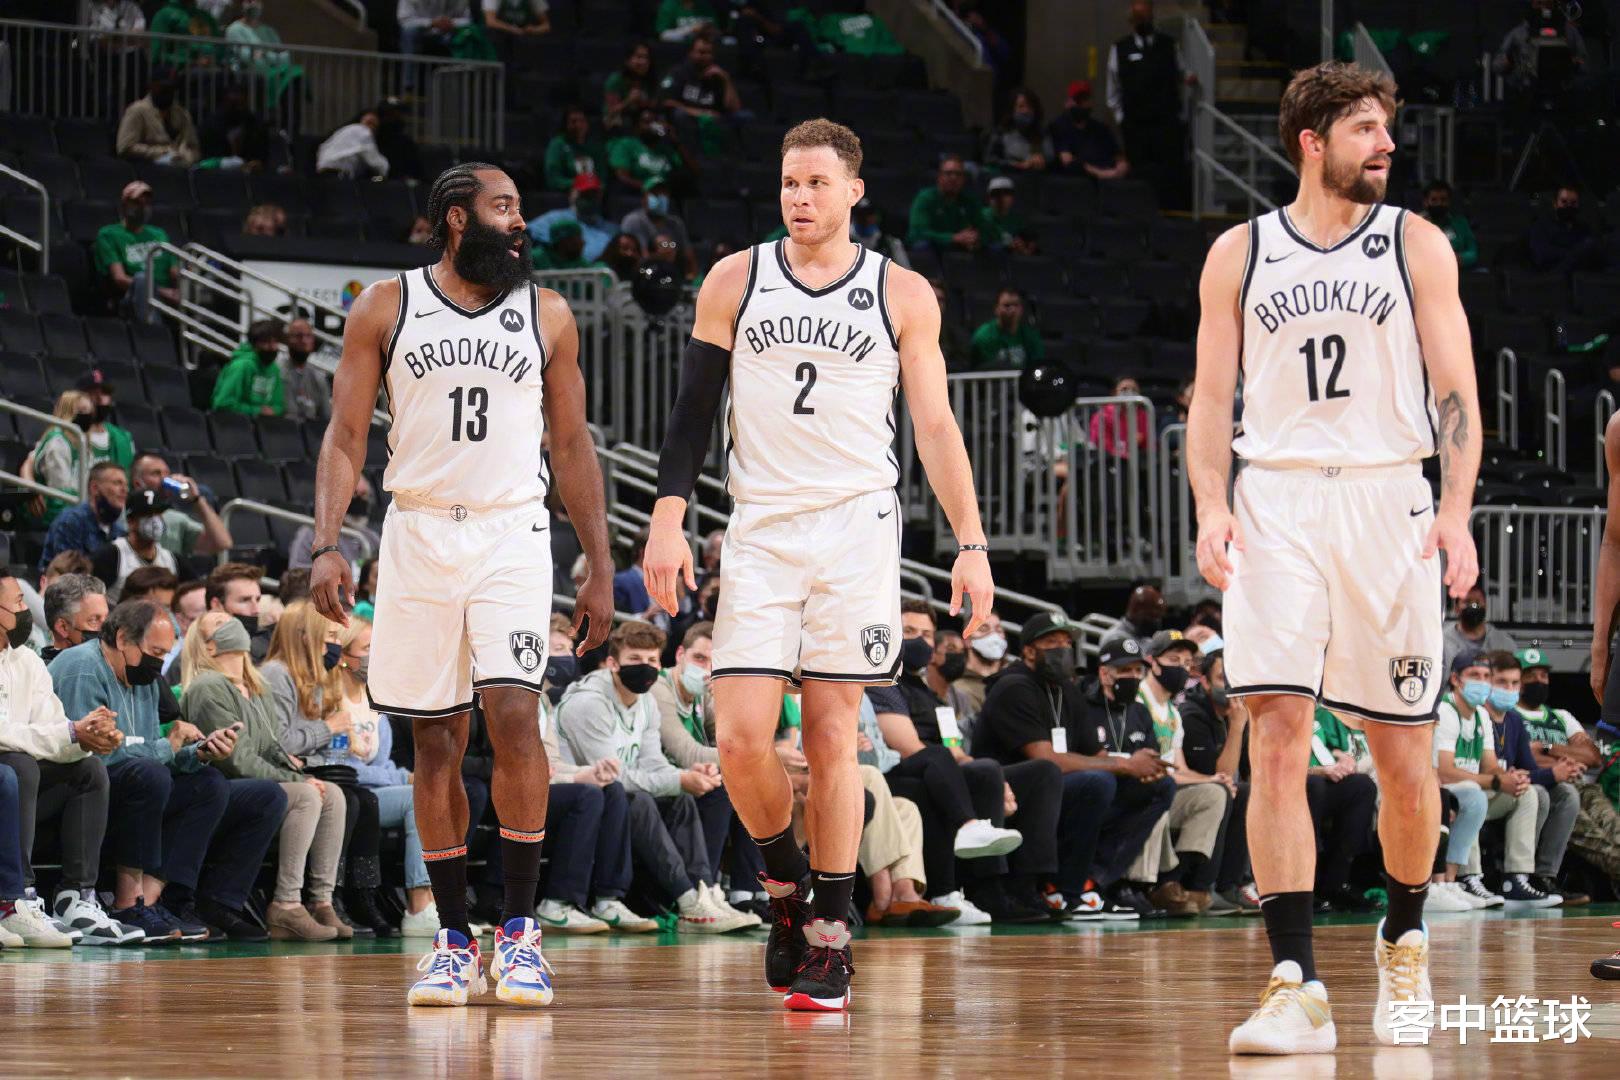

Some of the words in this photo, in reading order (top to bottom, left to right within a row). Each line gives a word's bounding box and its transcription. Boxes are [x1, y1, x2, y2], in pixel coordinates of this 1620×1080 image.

[1254, 279, 1397, 334] BROOKLYN
[404, 337, 533, 384] BROOKLYN
[744, 316, 877, 363] BROOKLYN
[793, 361, 818, 415] 2
[1299, 334, 1351, 402] 12
[448, 386, 489, 442] 13
[143, 490, 155, 506] 7
[512, 633, 544, 656] NETS
[863, 627, 891, 647] NETS
[1393, 659, 1432, 679] NETS
